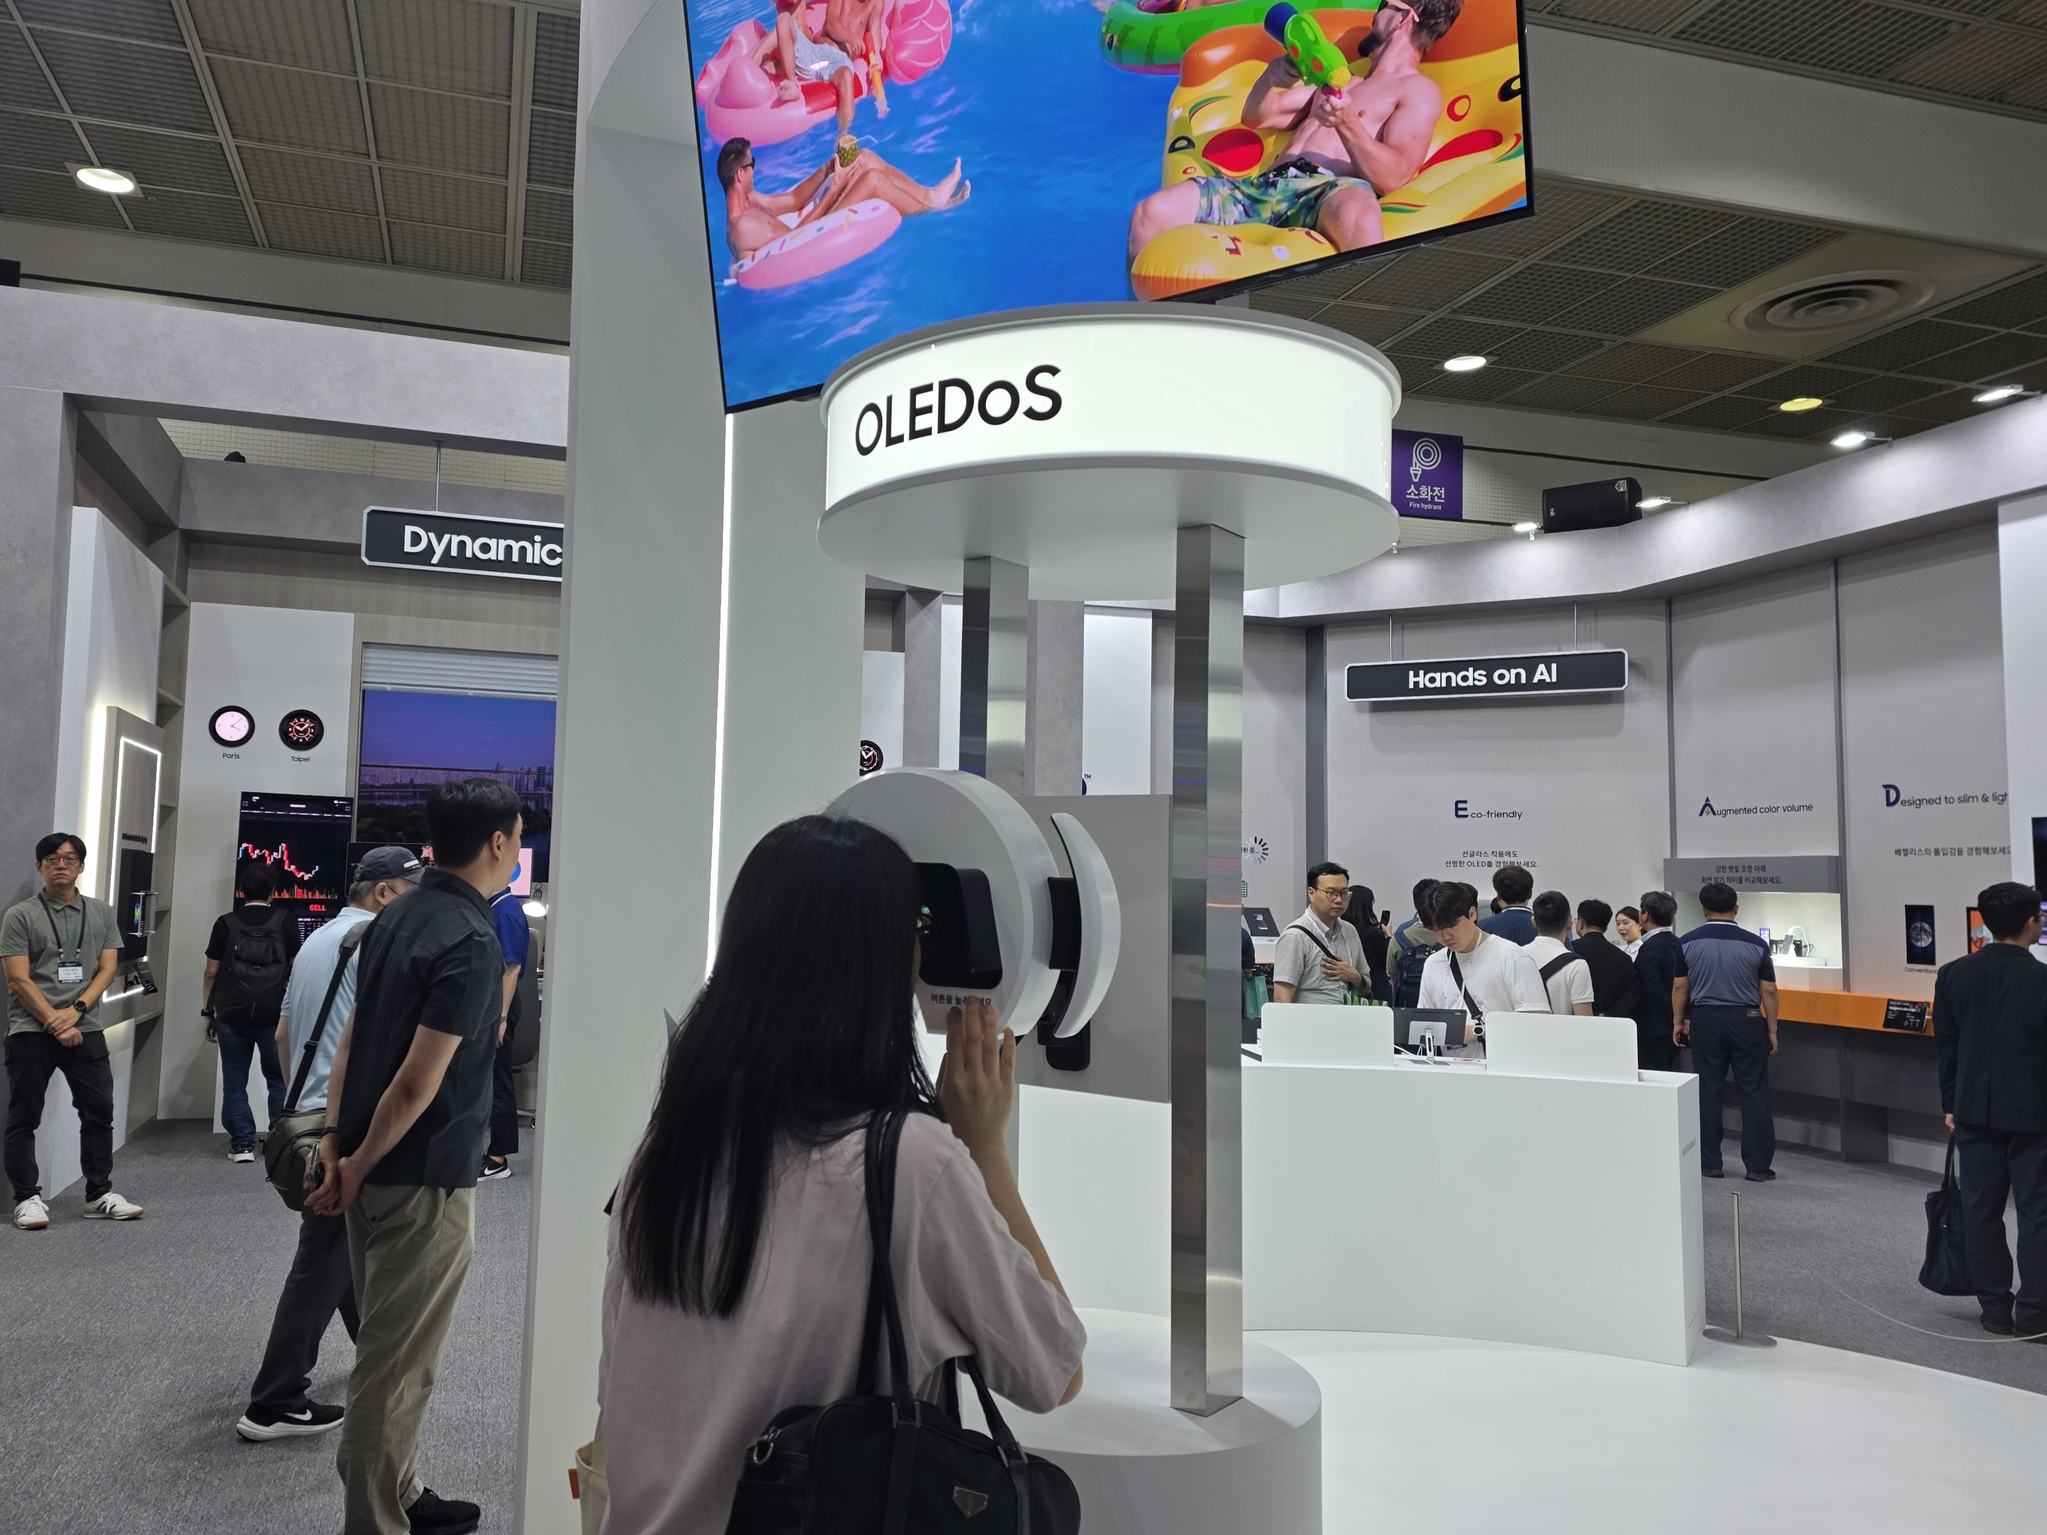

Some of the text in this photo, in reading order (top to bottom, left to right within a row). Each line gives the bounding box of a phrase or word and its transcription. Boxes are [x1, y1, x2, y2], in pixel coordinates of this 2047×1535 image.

[855, 364, 1063, 456] OLEDoS
[1406, 484, 1445, 503] 소화전
[1409, 501, 1442, 511] Fire hydrant
[403, 525, 563, 567] Dynamic
[1408, 663, 1557, 689] Hands on AI
[222, 752, 241, 760] Paris
[291, 755, 311, 763] Taipei
[1882, 783, 1942, 810] Designed
[1944, 795, 1955, 805] to
[1957, 793, 1979, 804] slim
[1981, 793, 1989, 803] &
[1454, 799, 1523, 820] Eco-friendly
[1698, 796, 1814, 818] Augmented color volume
[1461, 850, 1519, 858] 선글라스 착용에도
[1894, 848, 1931, 857] 베젤리스의
[1444, 860, 1466, 868] 선명한
[1466, 860, 1494, 868] OLED를
[1715, 865, 1727, 874] 강한
[1741, 865, 1753, 873] 조명
[1754, 865, 1766, 873] 아래
[1726, 876, 1743, 884] 차이를
[1744, 876, 1783, 885] 비교해보세요.
[309, 904, 327, 912] SELL
[930, 993, 953, 1005] 버튼을
